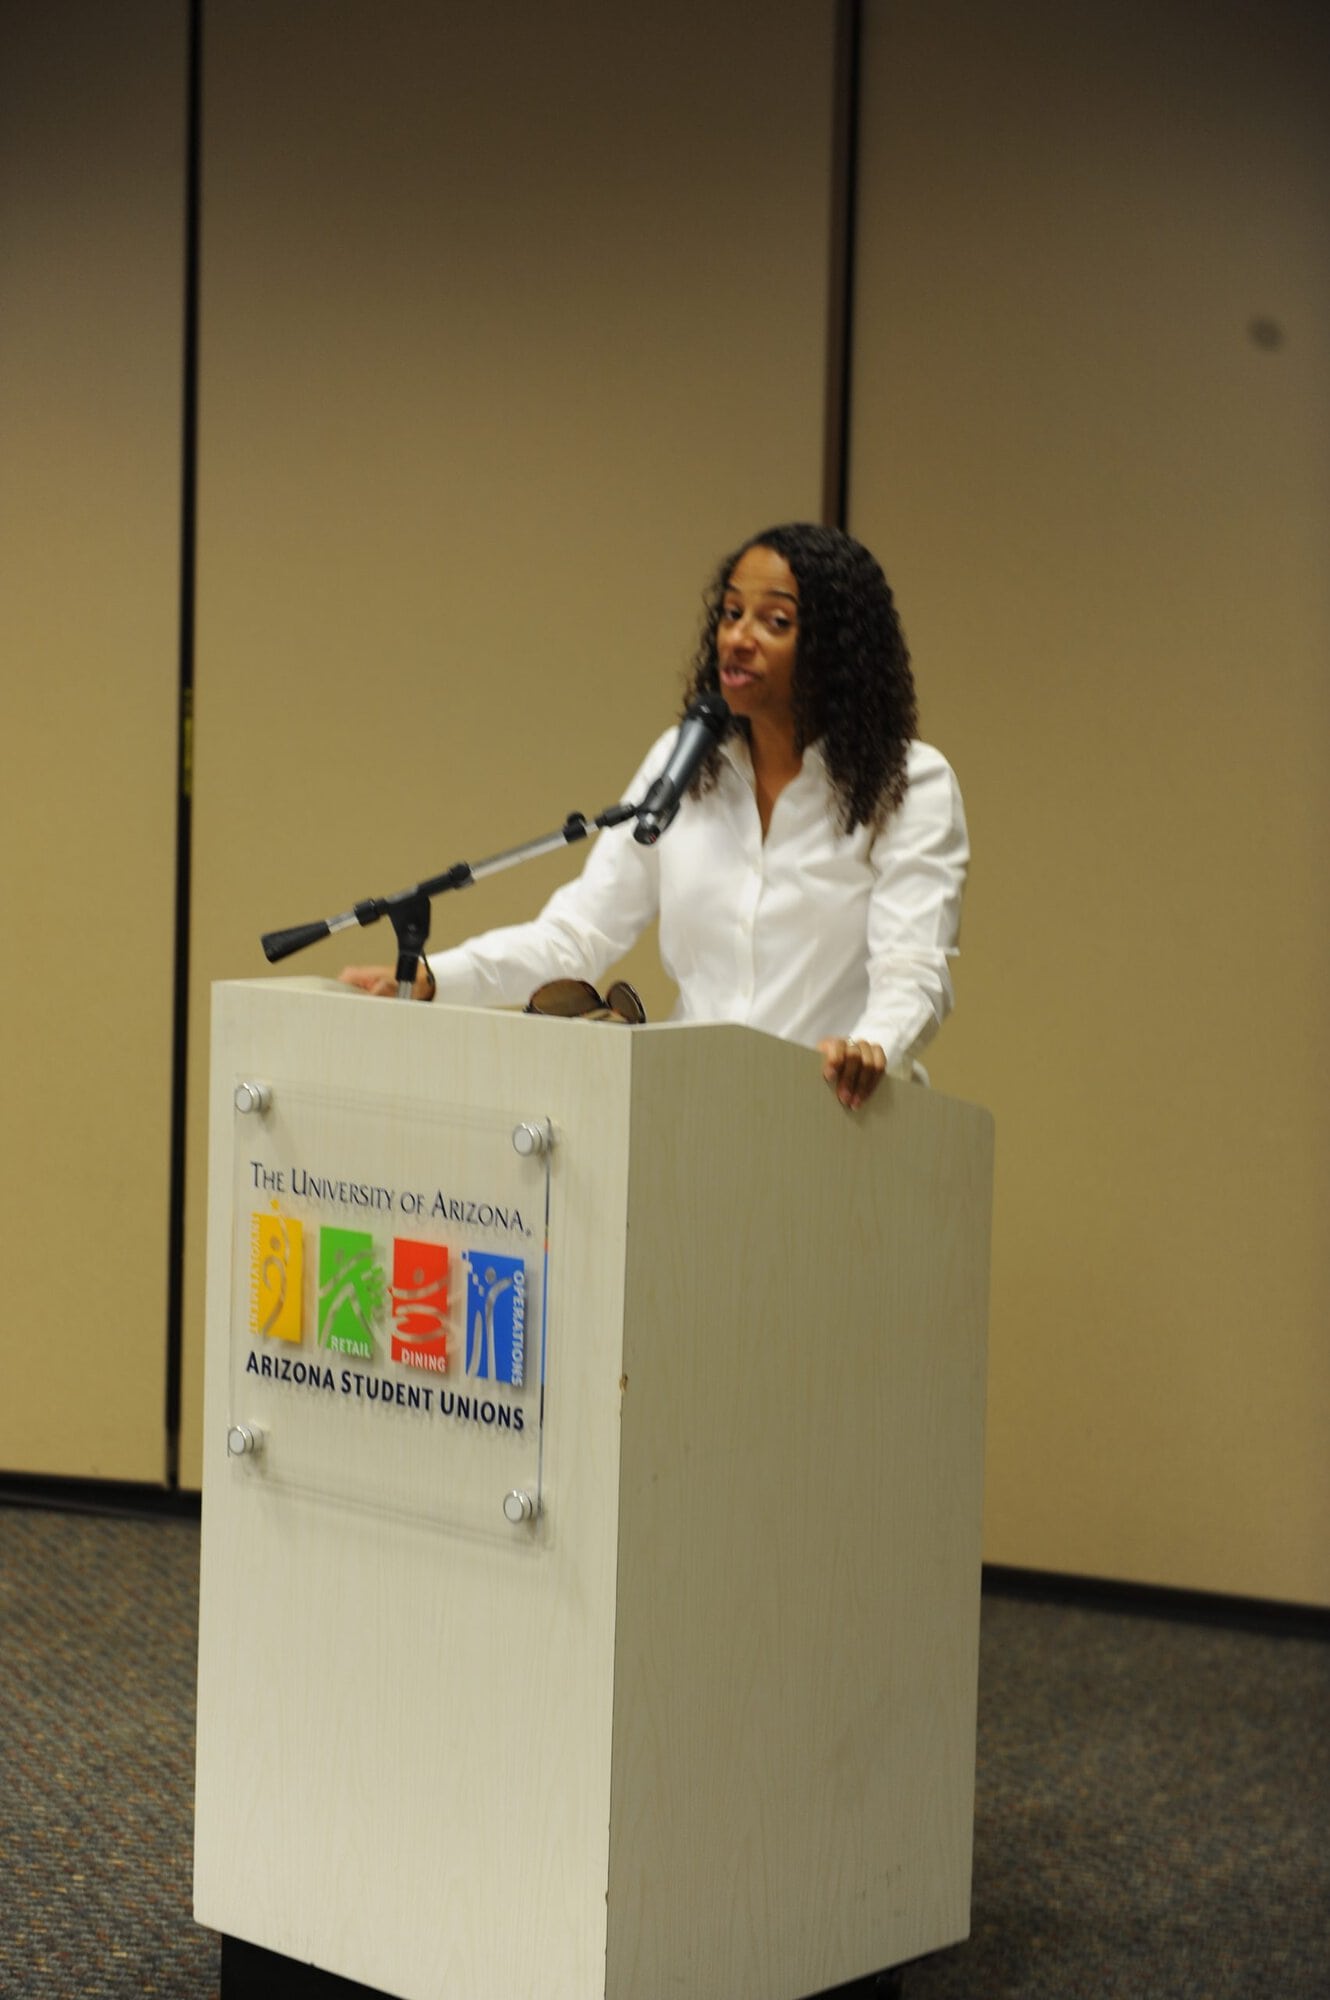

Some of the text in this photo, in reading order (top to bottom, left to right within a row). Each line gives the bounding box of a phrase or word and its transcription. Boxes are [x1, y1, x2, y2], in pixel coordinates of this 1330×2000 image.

[250, 1161, 285, 1194] THE
[291, 1168, 396, 1211] UNIVERSITY
[400, 1192, 426, 1216] OF
[331, 1336, 371, 1359] RETAIL
[511, 1269, 525, 1387] OPERATIONS
[401, 1347, 446, 1373] DINING
[246, 1351, 524, 1431] ARIZONA STUDENT UNIONS
